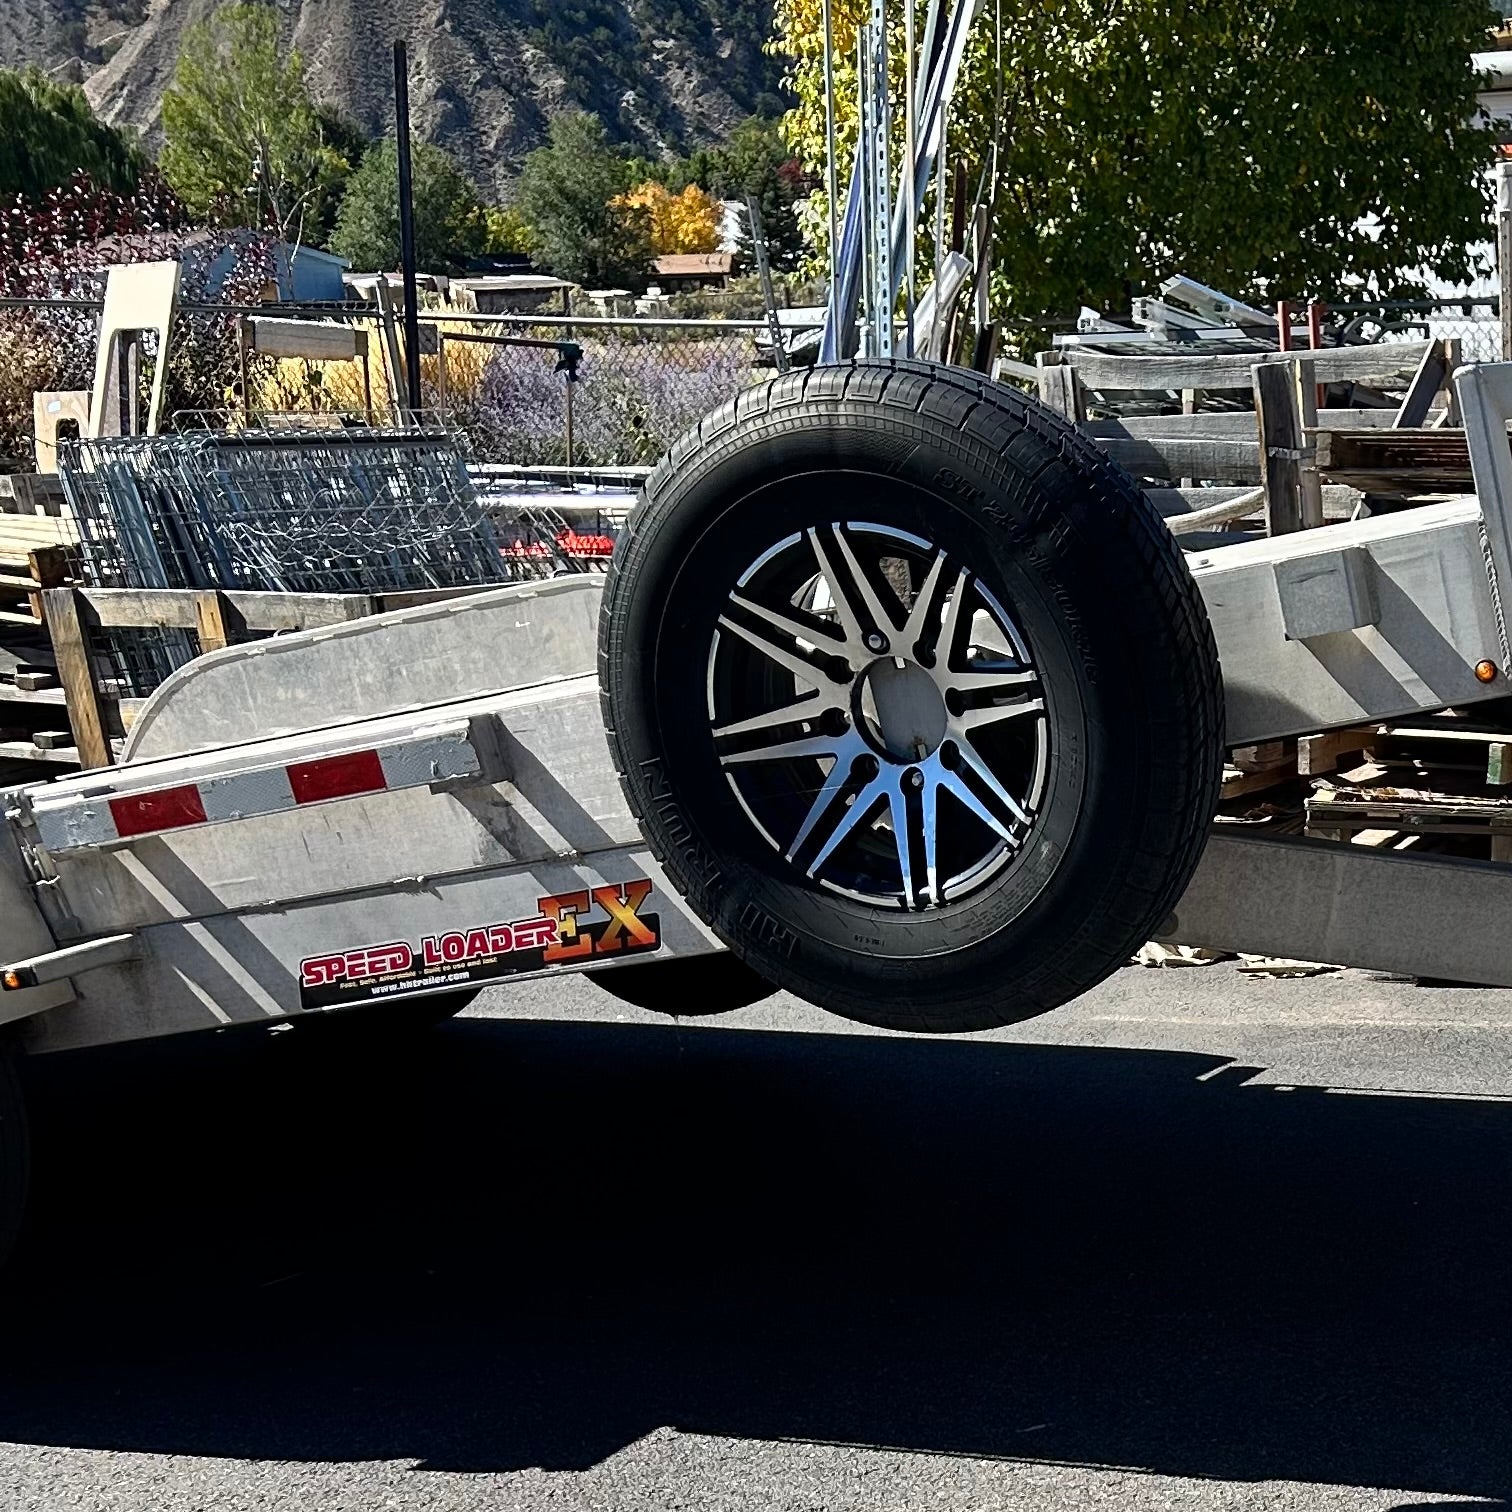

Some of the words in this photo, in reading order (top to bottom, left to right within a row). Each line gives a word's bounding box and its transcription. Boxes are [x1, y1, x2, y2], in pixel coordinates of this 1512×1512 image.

[302, 943, 412, 987] SPEED
[421, 917, 562, 966] LOADER
[537, 878, 657, 964] EX
